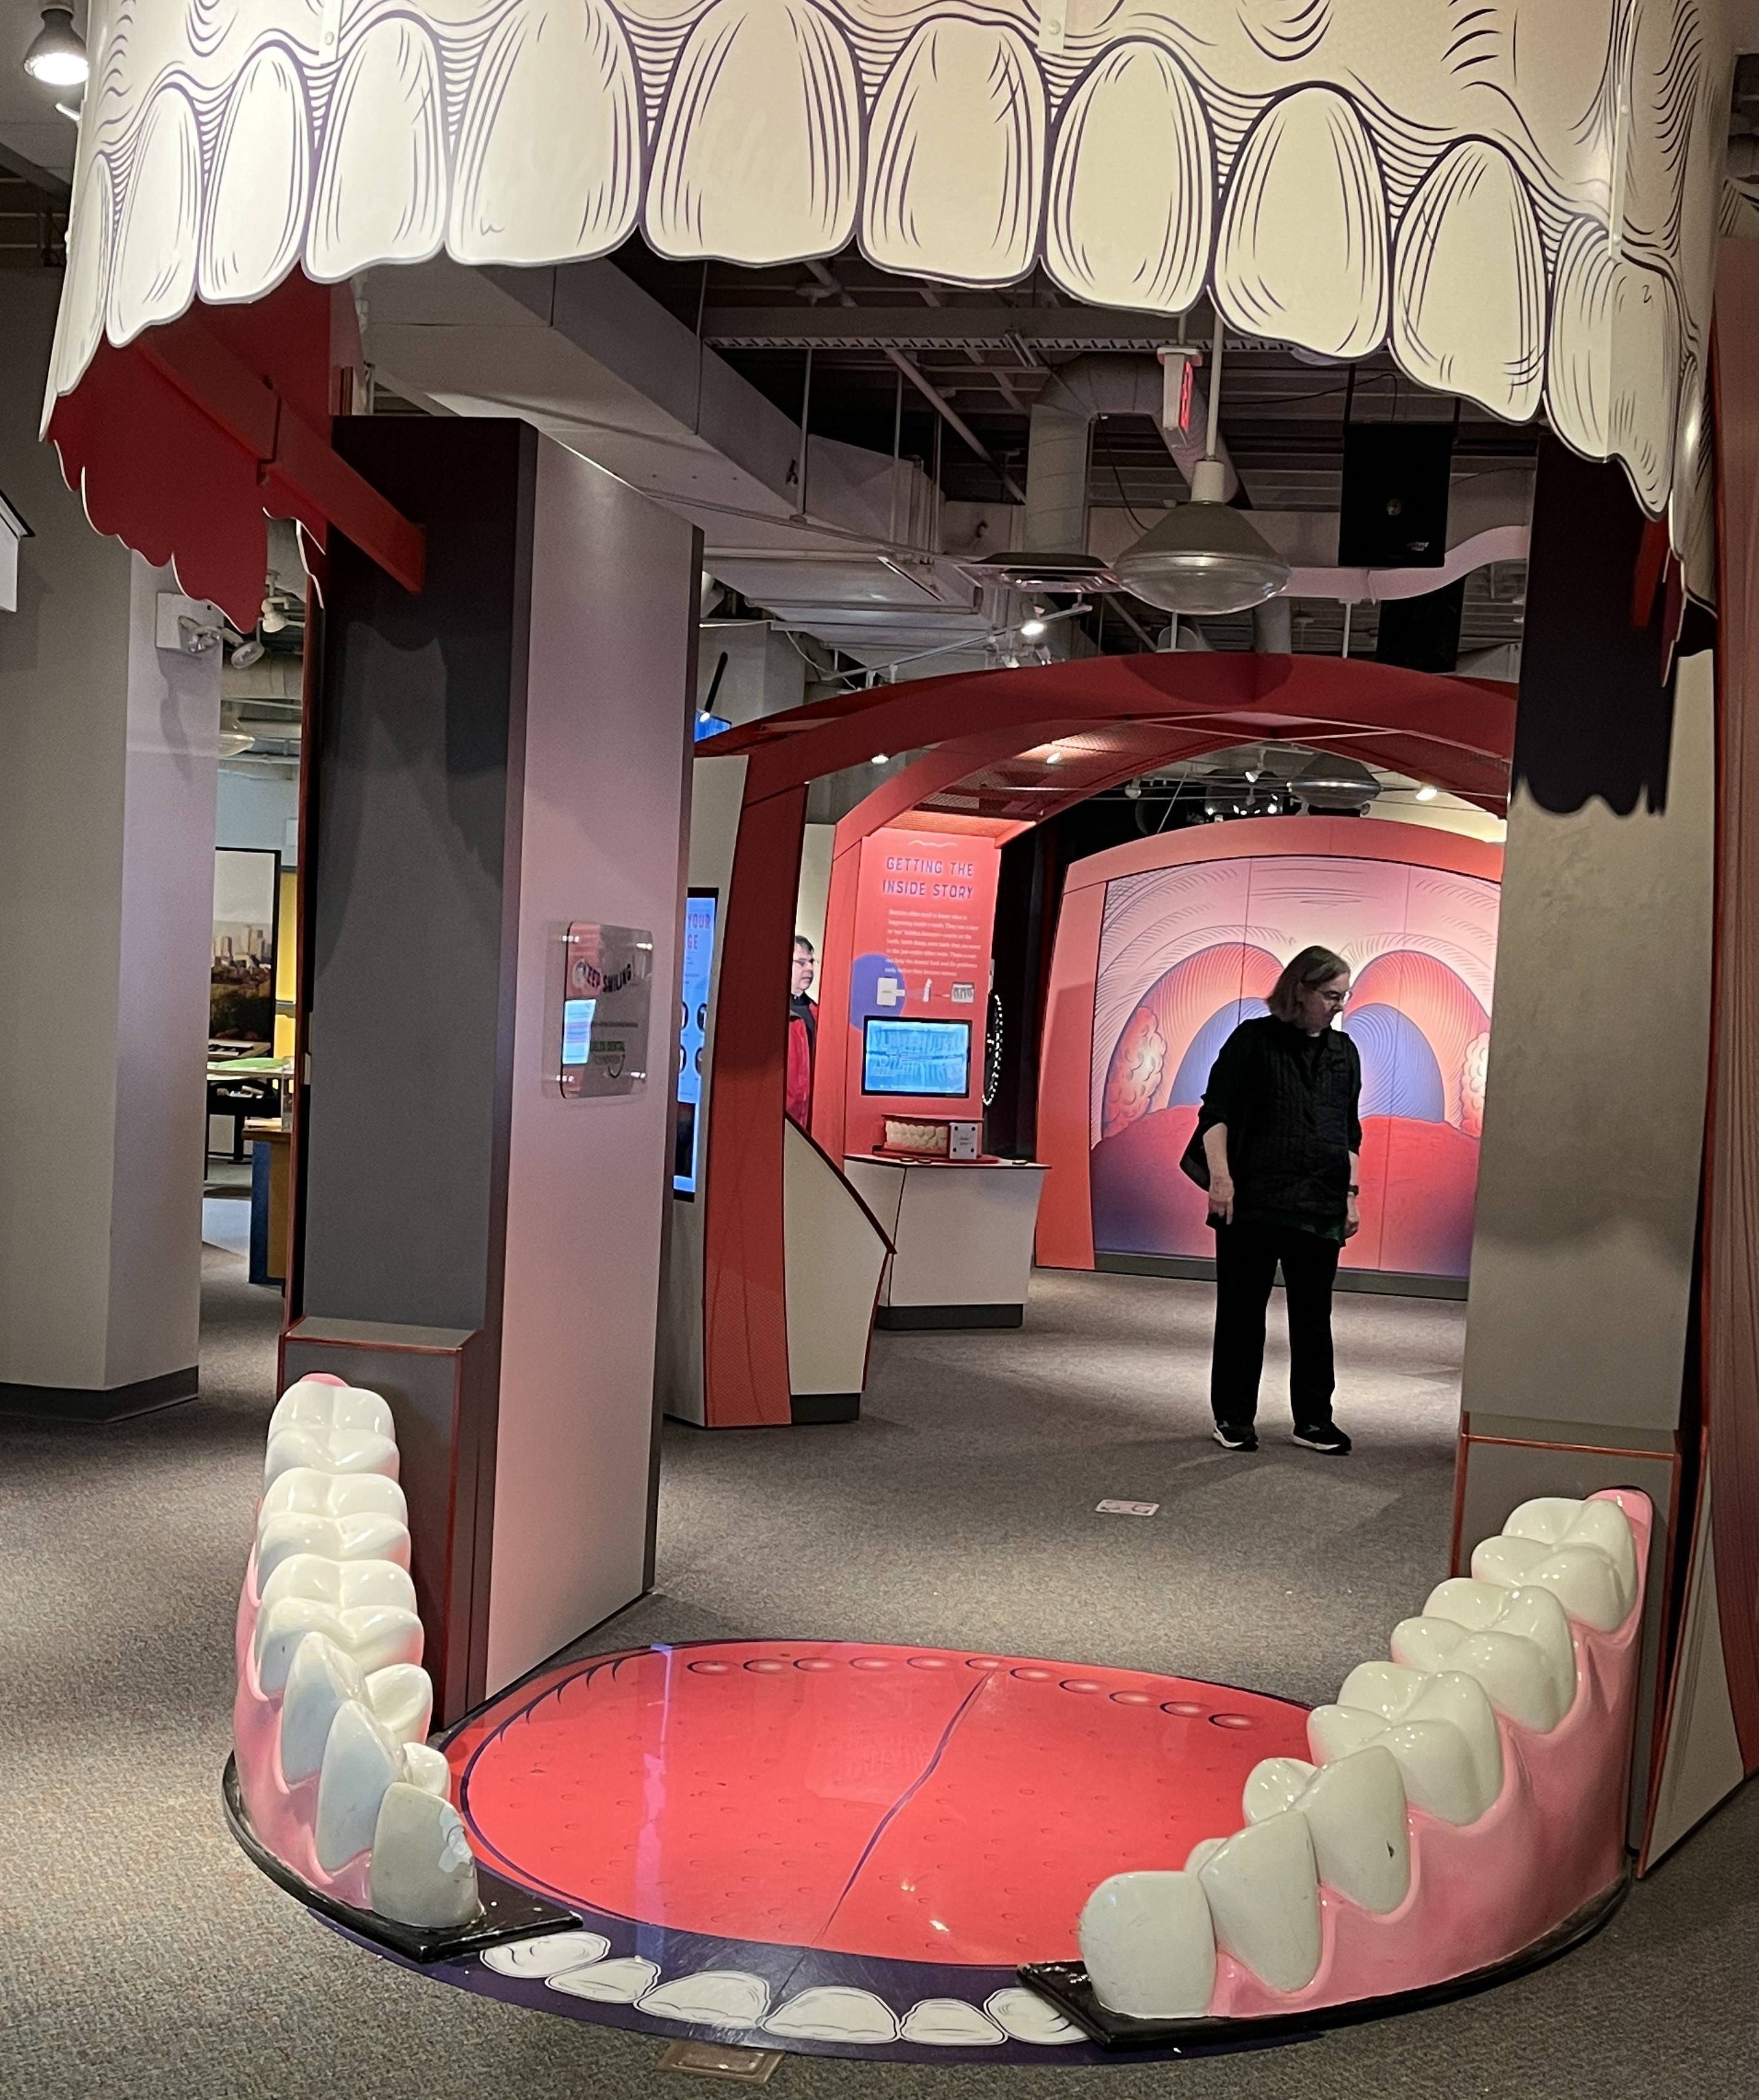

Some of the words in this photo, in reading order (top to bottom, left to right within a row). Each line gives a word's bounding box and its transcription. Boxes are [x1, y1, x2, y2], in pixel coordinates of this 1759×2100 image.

[886, 857, 942, 873] GETTING
[950, 862, 974, 877] THE
[883, 879, 926, 896] INSIDE
[932, 884, 973, 899] STORY
